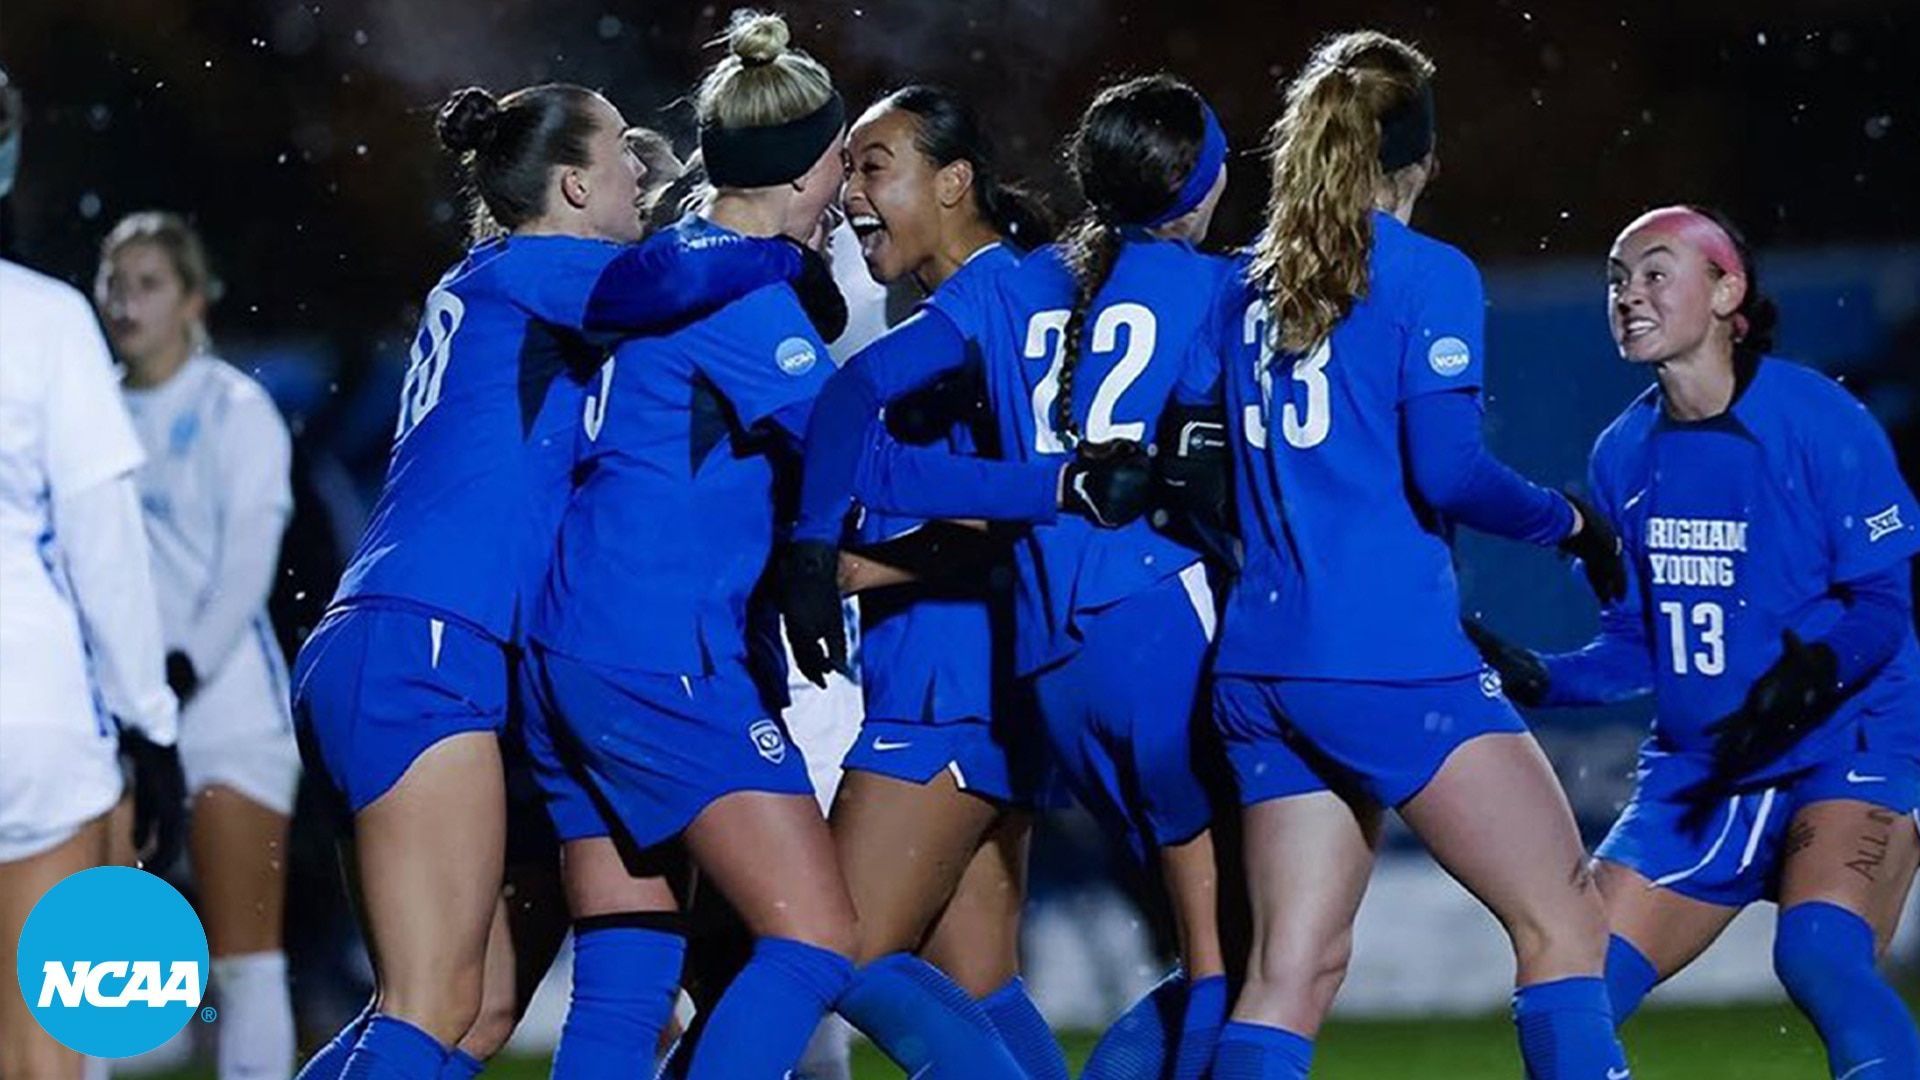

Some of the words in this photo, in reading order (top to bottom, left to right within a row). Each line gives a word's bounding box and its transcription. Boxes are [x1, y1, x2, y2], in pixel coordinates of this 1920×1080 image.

[1023, 302, 1157, 455] 22
[1646, 518, 1748, 552] RIGHAM
[1649, 554, 1735, 587] YOUNG
[1660, 602, 1725, 676] 13
